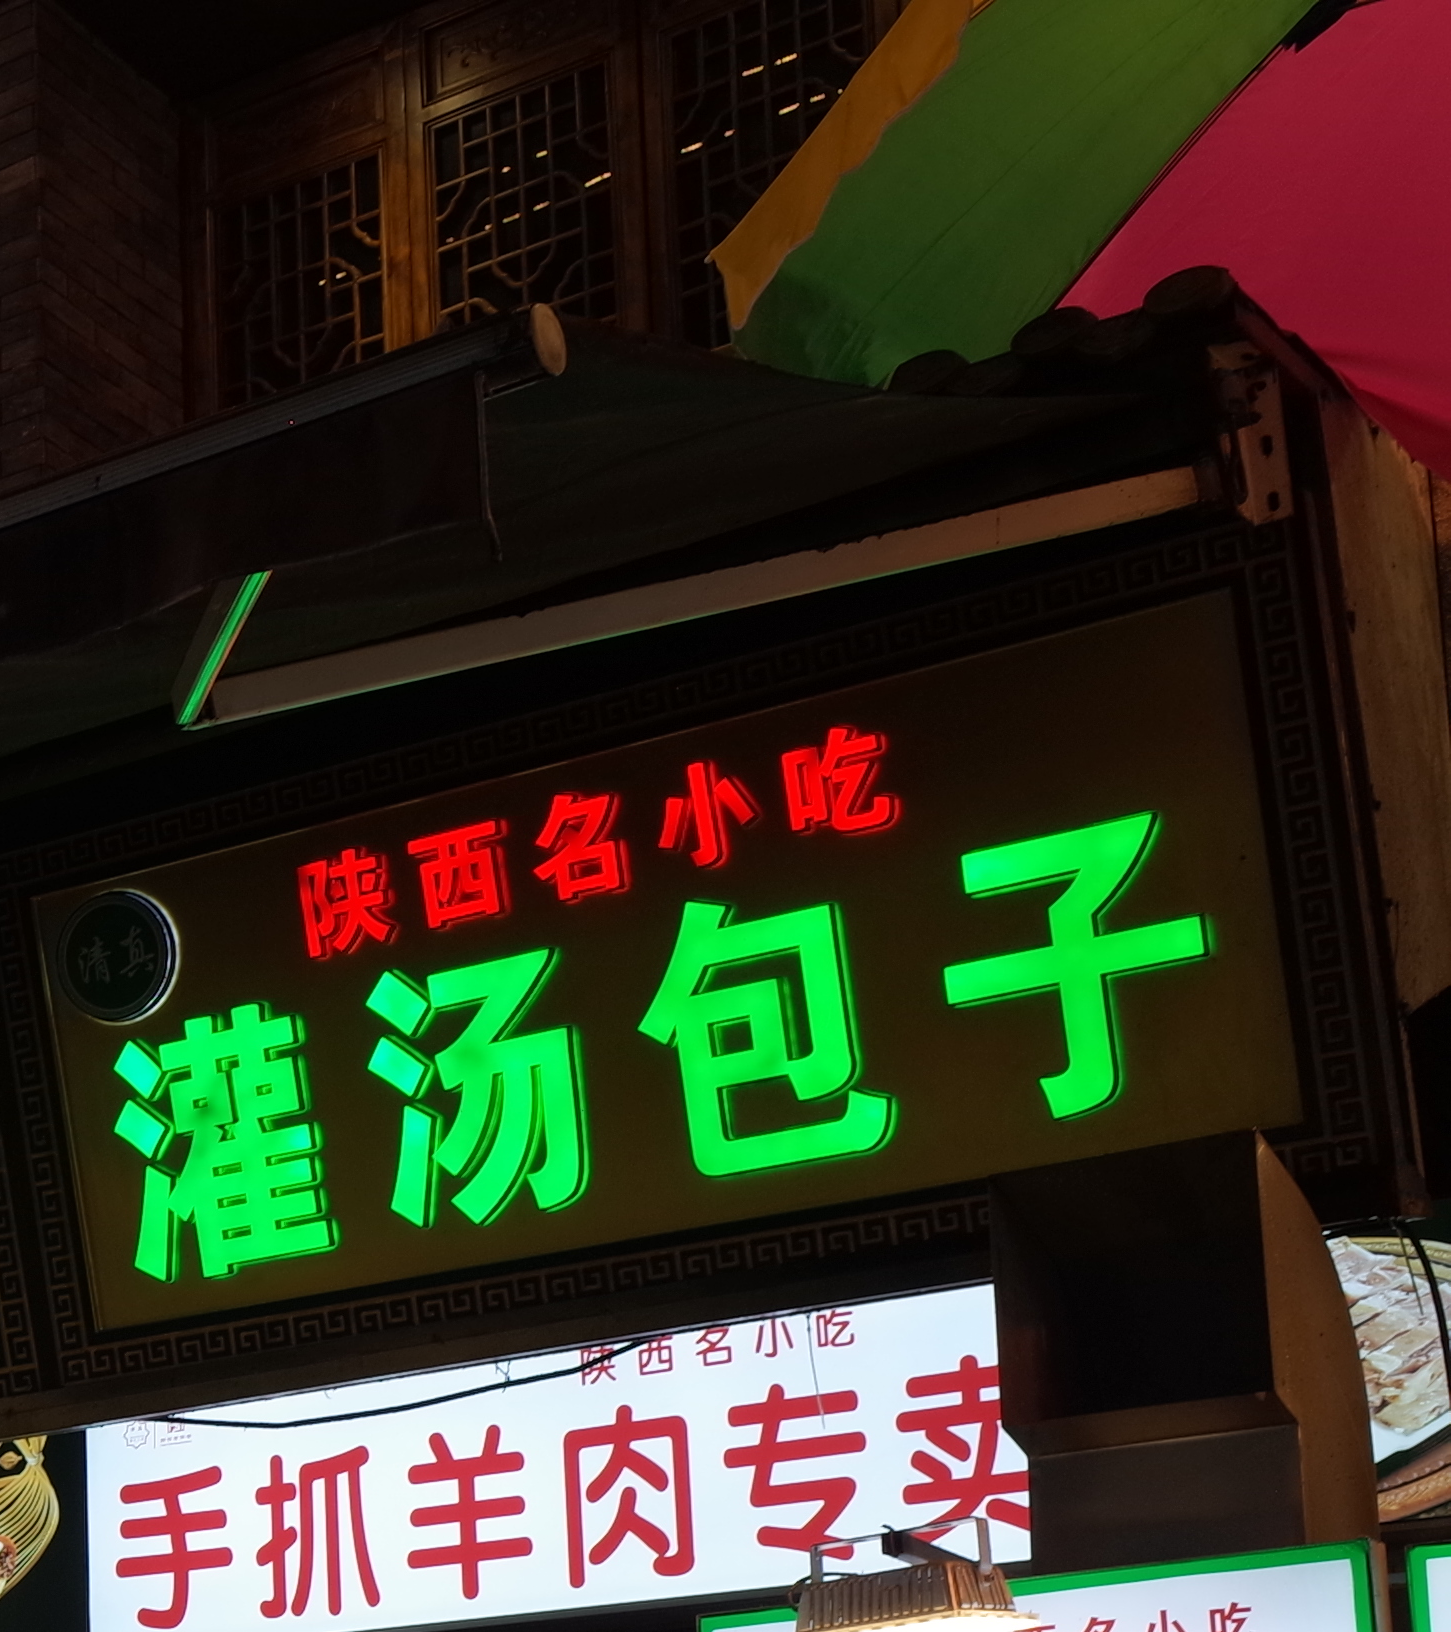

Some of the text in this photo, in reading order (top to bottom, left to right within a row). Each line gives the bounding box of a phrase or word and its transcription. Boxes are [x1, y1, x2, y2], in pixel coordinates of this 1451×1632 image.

[298, 726, 901, 960] 陕西名小吃
[77, 931, 157, 990] 清真
[113, 810, 1213, 1284] 灌汤包子
[579, 1308, 857, 1386] 陕西名小吃
[115, 1354, 1030, 1631] 手抓羊肉专卖
